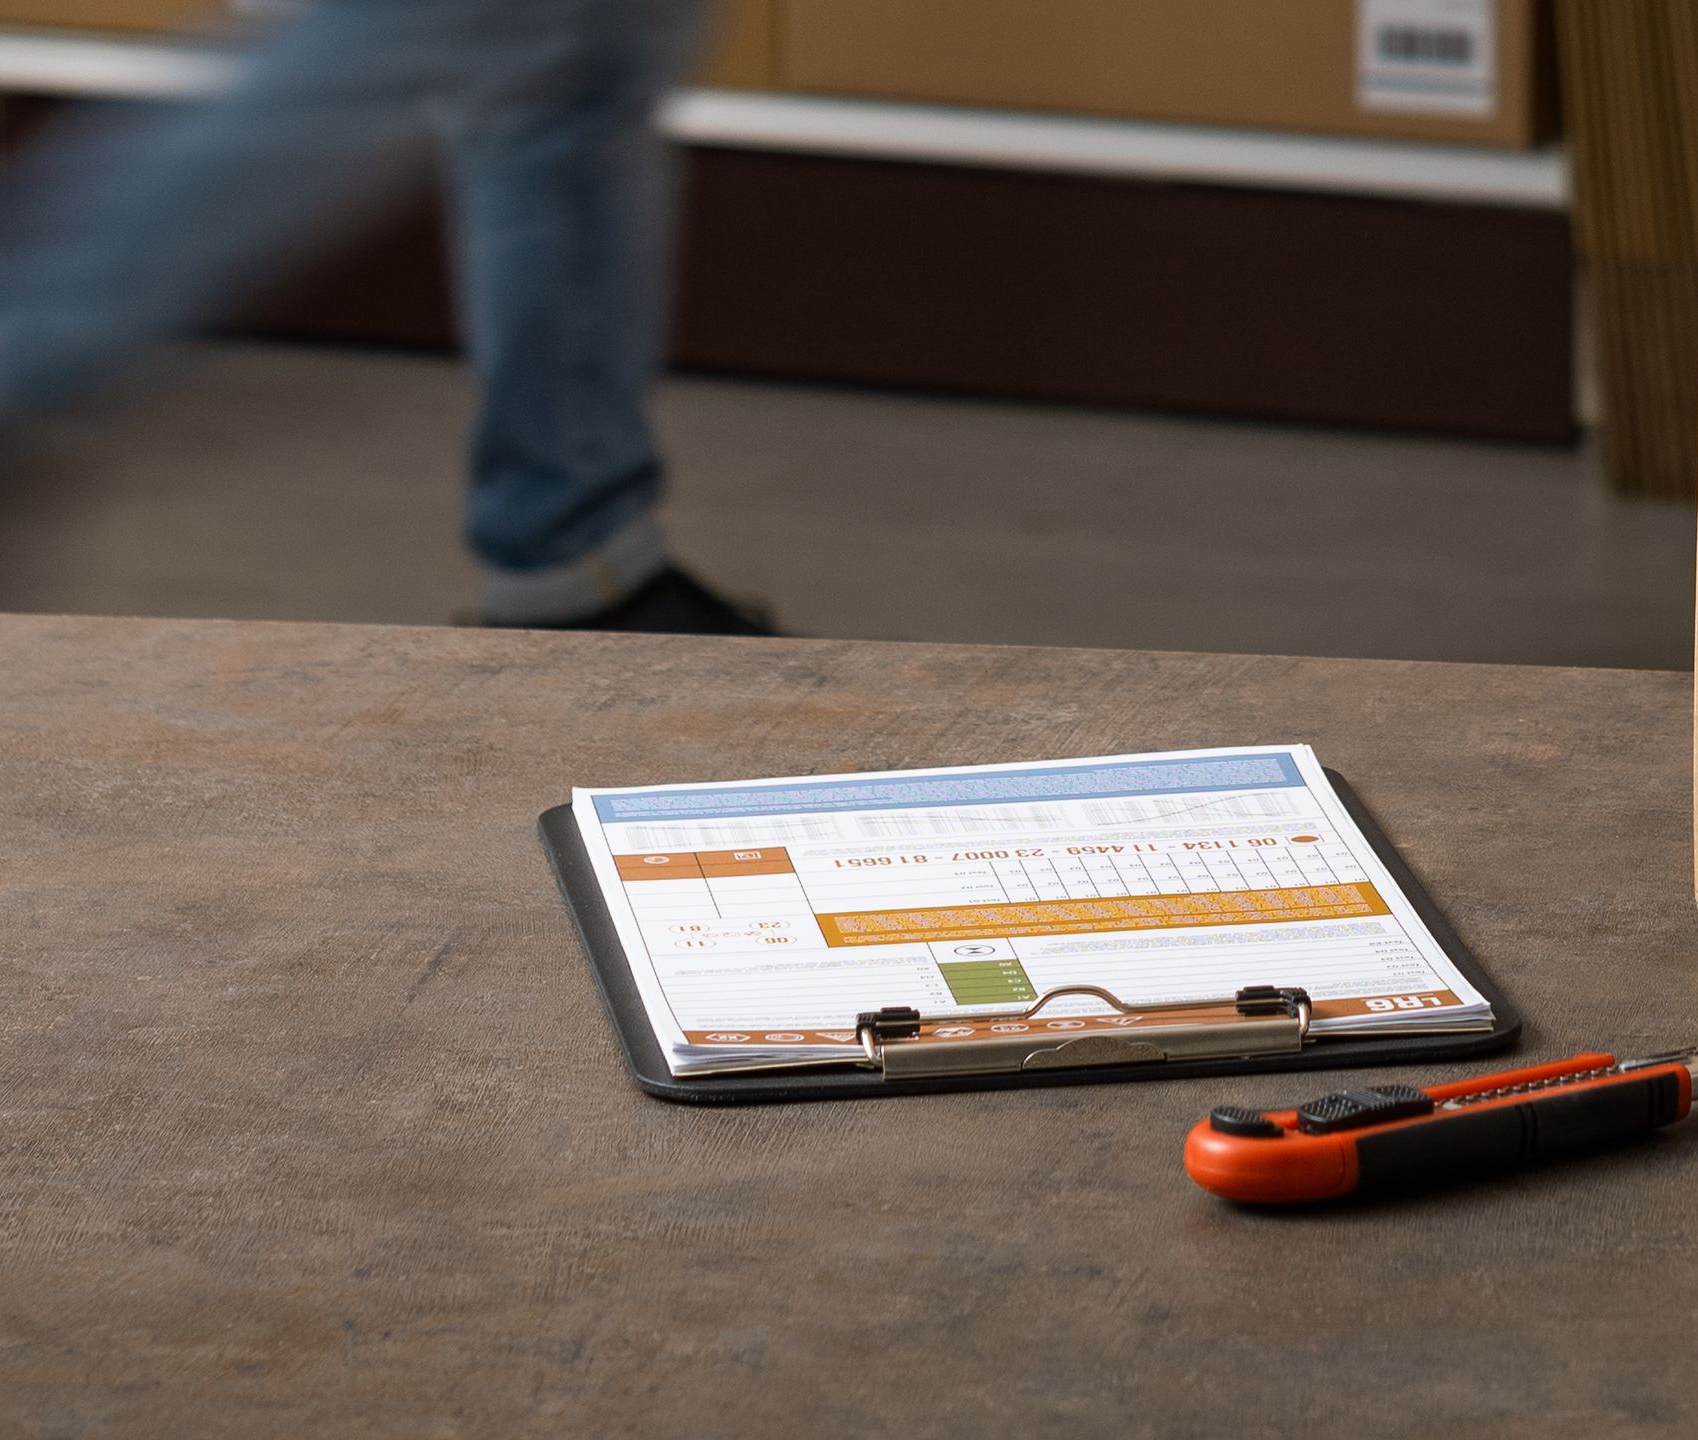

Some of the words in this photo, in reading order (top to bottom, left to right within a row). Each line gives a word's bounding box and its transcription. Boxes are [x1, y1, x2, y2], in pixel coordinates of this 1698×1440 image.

[1133, 843, 1158, 852] 11
[1182, 840, 1239, 850] 1134
[1247, 837, 1277, 848] 06
[951, 850, 1009, 862] 0007
[1014, 848, 1044, 858] 23
[1065, 845, 1125, 856] 4459
[833, 856, 892, 869] 6651
[899, 854, 928, 864] 81
[1365, 994, 1443, 1012] LR6
